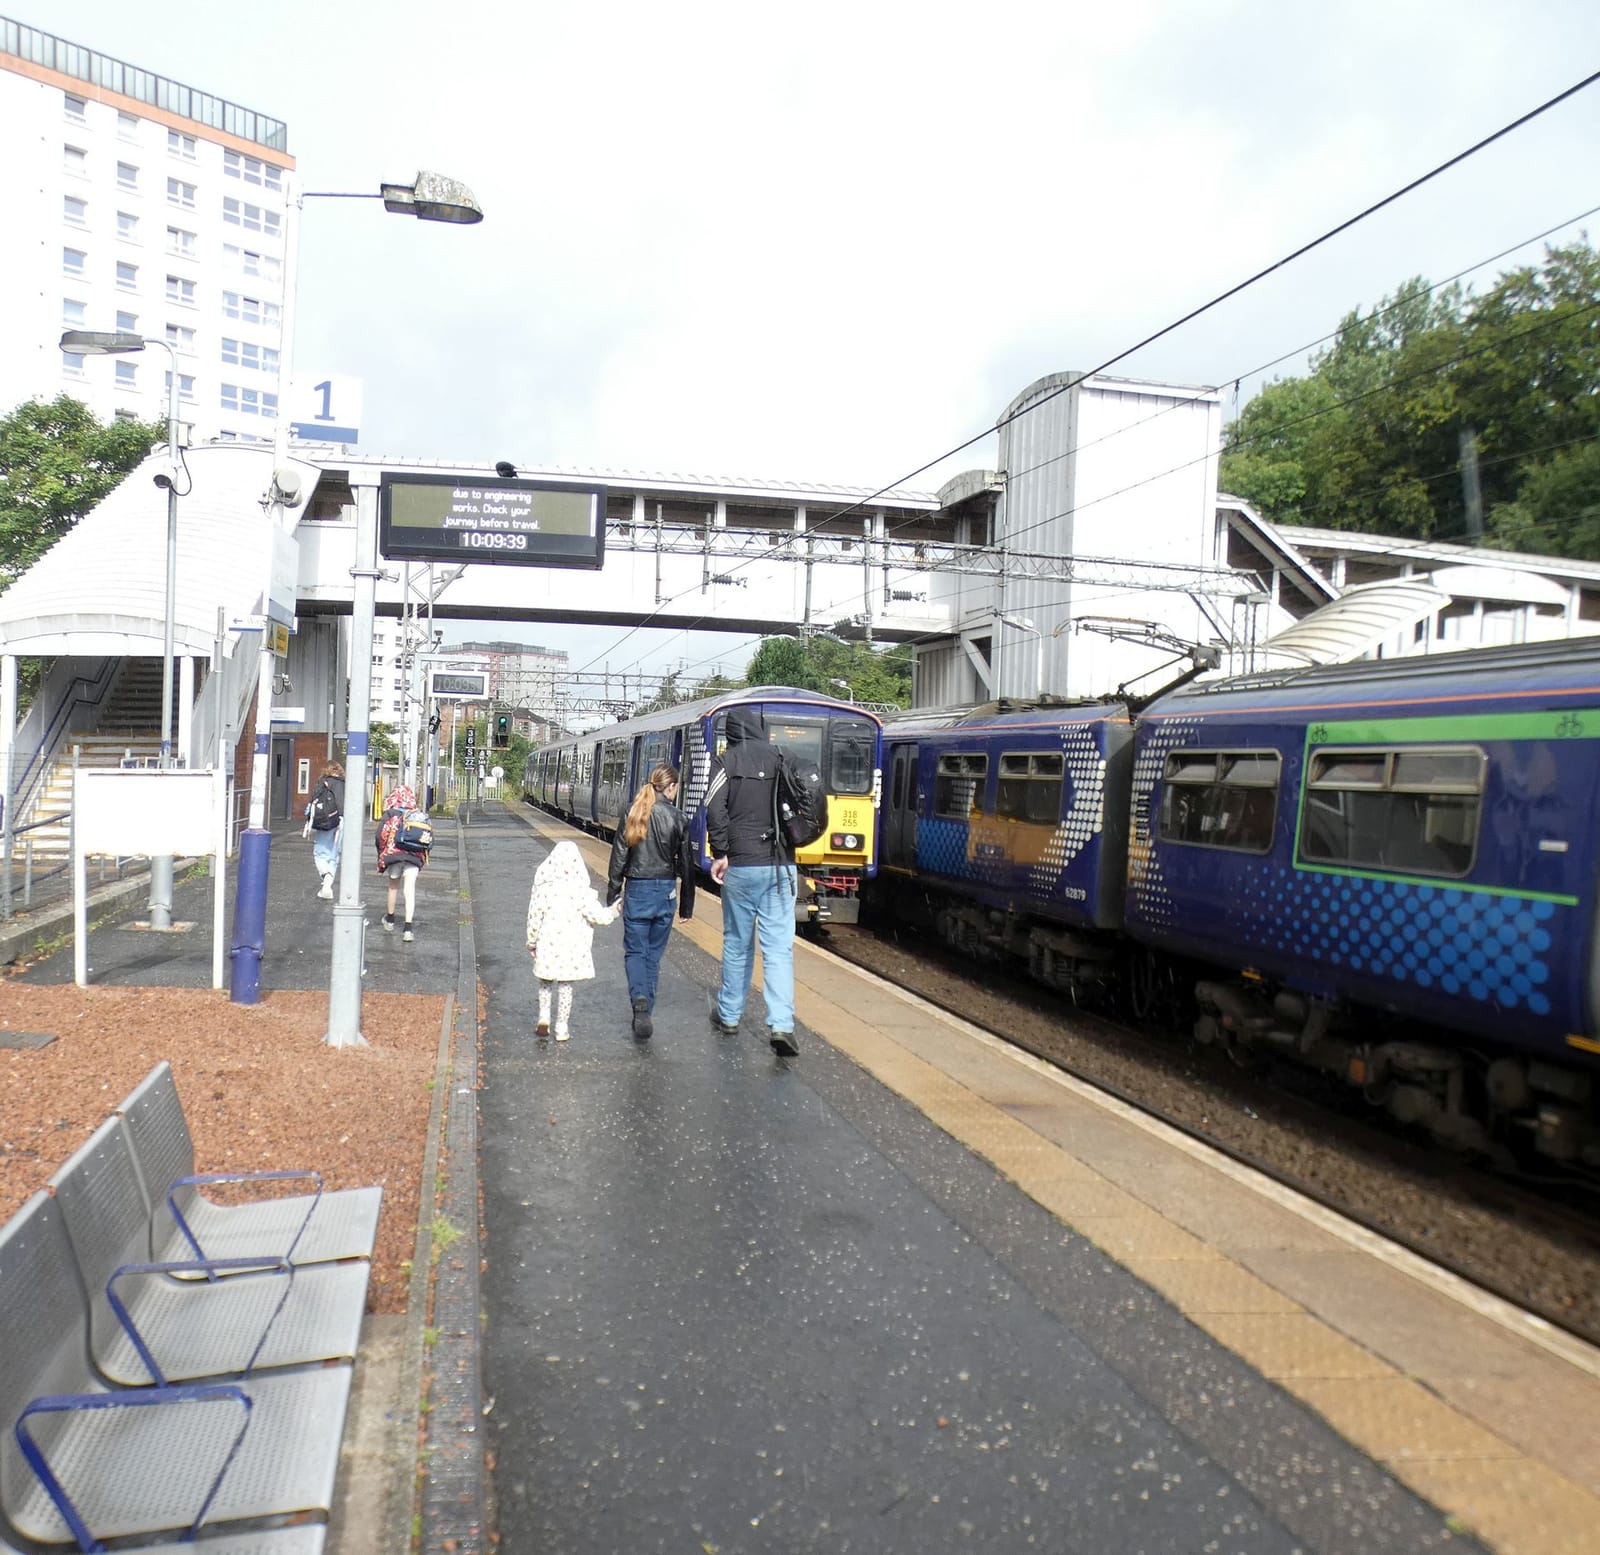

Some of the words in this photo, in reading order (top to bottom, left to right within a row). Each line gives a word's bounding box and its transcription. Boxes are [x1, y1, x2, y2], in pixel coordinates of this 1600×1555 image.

[313, 380, 335, 421] 1
[453, 488, 468, 498] due
[472, 490, 481, 499] to
[484, 492, 532, 504] engineering
[483, 503, 508, 515] Check
[511, 507, 531, 517] your
[443, 515, 478, 530] journey
[480, 517, 509, 528] before
[462, 532, 527, 550] 10:09:39
[842, 809, 858, 819] 318
[842, 818, 858, 827] 255
